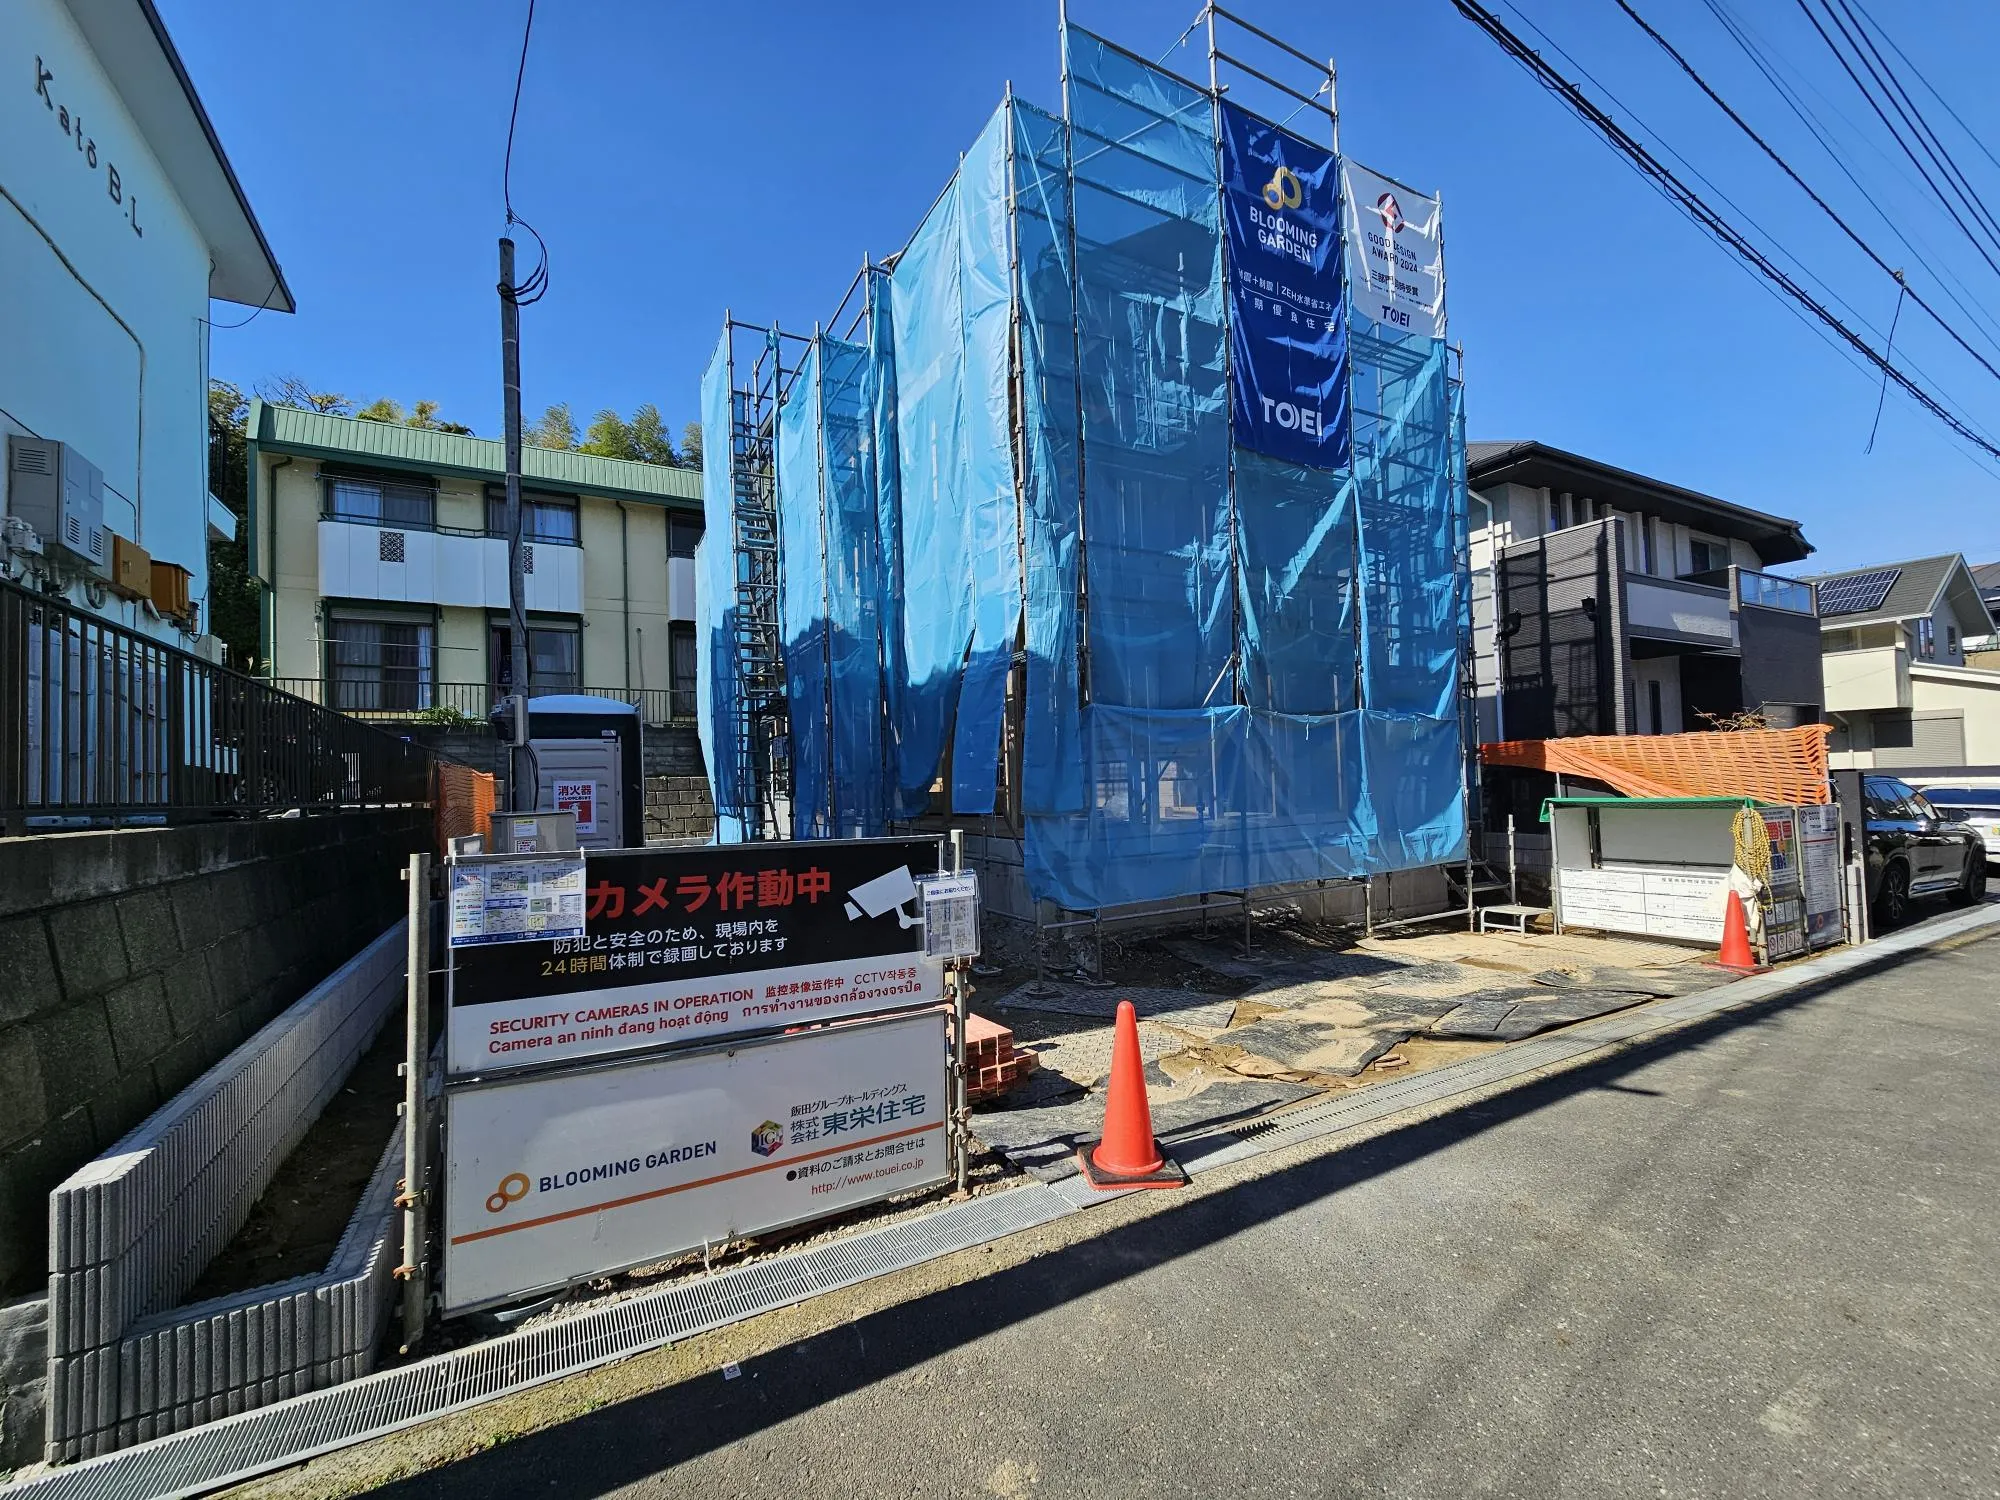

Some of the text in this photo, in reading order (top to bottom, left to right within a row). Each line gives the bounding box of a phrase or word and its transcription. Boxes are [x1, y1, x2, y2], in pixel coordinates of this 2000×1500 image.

[1250, 205, 1317, 248] BLOOMING
[1258, 228, 1311, 262] GARDEN
[1367, 232, 1391, 248] GOOD
[1372, 246, 1418, 273] AWARD 2024
[558, 784, 592, 796] 消火器
[586, 866, 831, 920] カメラ作動中
[553, 918, 779, 955] 防犯と安全のため、現場内を
[541, 936, 788, 976] 24時間体制で録画しております
[765, 976, 845, 999] 监控录像运作中
[854, 967, 917, 985] CCTV작동중
[489, 989, 753, 1035] SECURITY CAMERAS IN OPERATION
[742, 980, 922, 1018] การทำงานของกล้องวงจรปิด
[488, 1010, 729, 1054] Camera an ninh đang hoạt động
[791, 1083, 908, 1118] 飯田グループホールディングス
[821, 1094, 926, 1137] 東栄住宅
[791, 1116, 820, 1132] 株式
[791, 1129, 820, 1145] 会社
[539, 1141, 717, 1193] BLOOMING GARDEN
[811, 1158, 924, 1195] http://www.touei.co.jp
